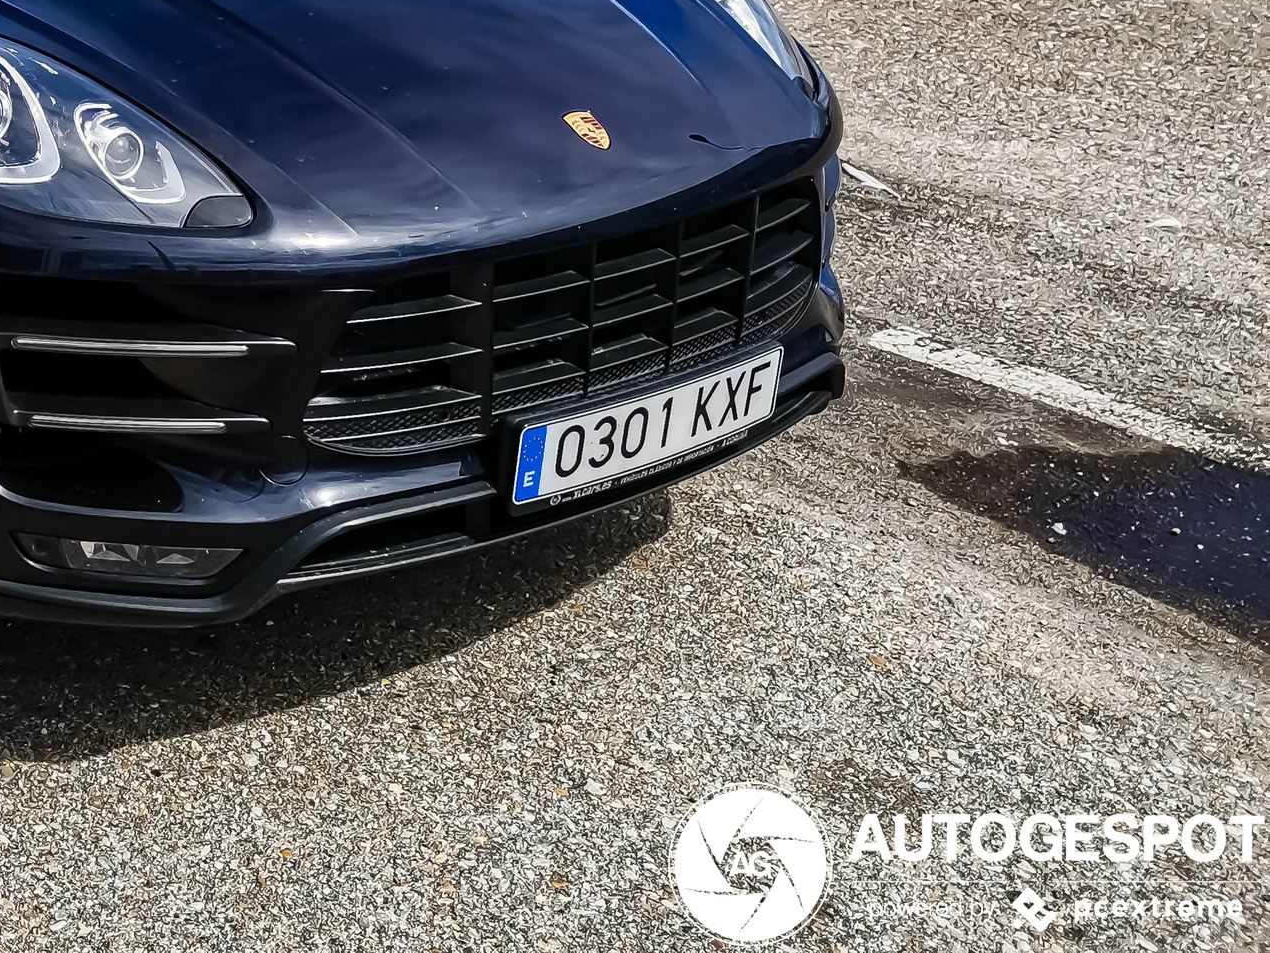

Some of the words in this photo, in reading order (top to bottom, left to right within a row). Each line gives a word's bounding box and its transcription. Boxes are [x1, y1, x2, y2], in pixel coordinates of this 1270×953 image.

[522, 470, 536, 487] E
[555, 396, 674, 477] 0301
[691, 360, 772, 437] KXF
